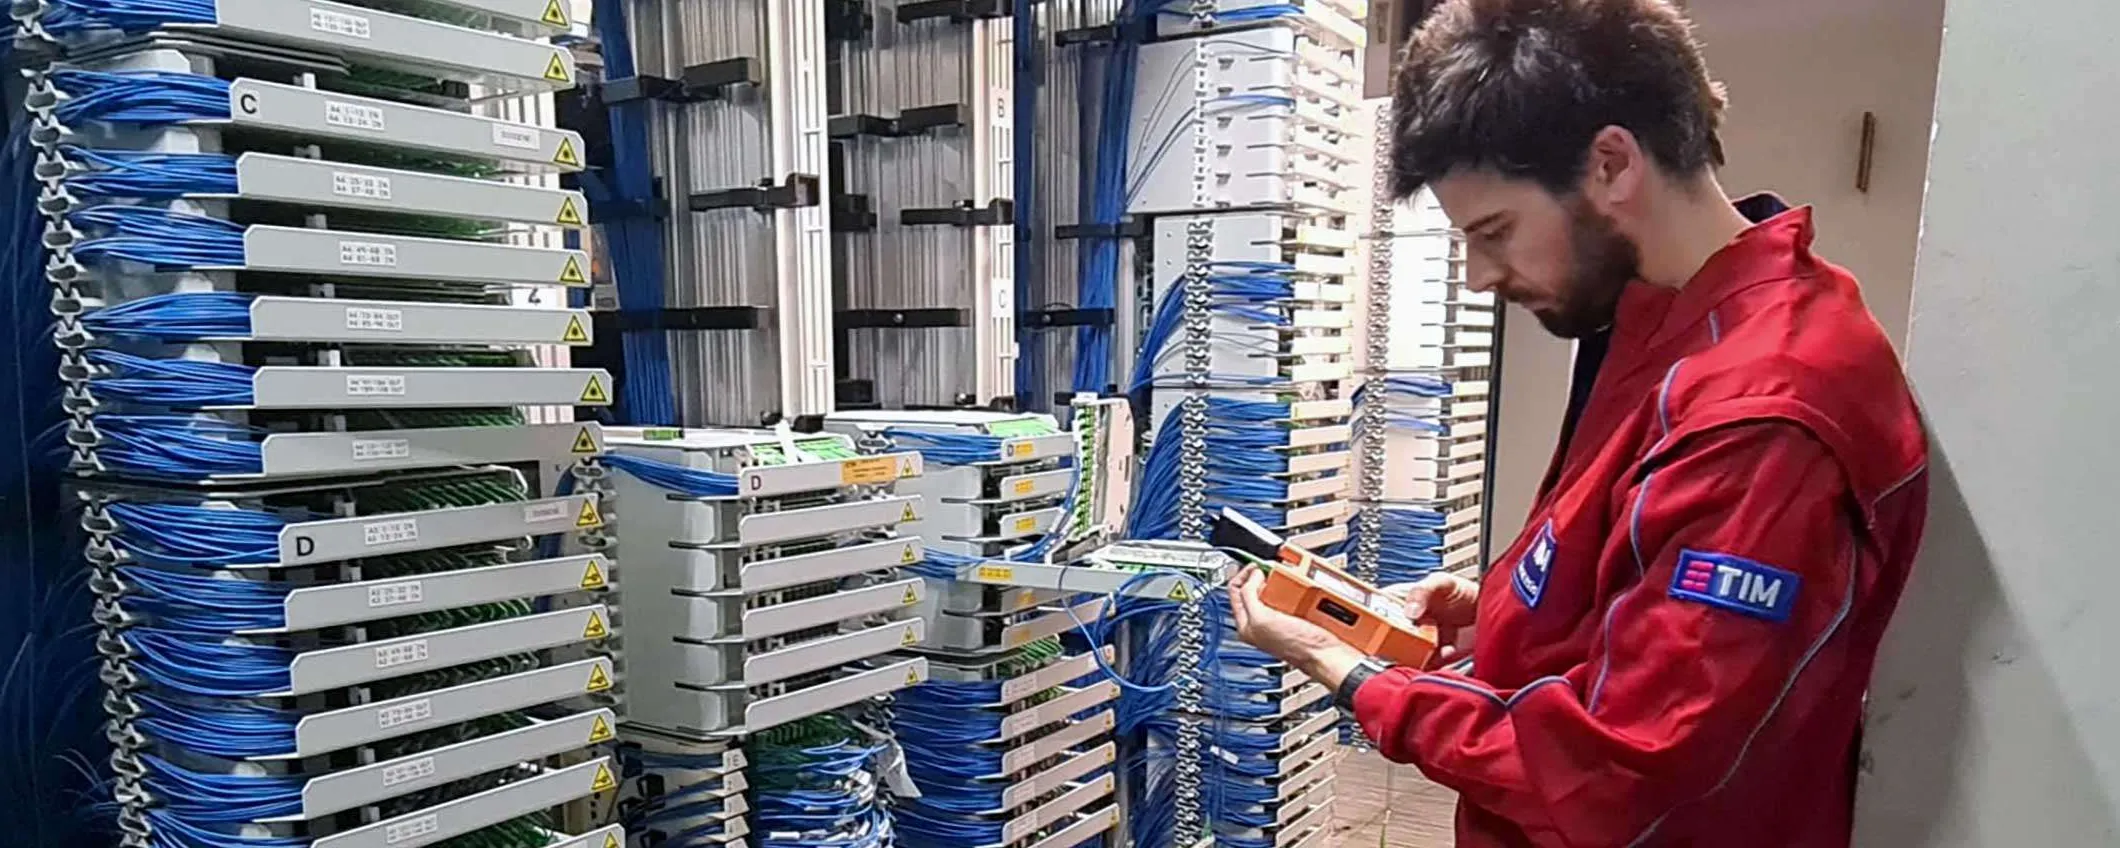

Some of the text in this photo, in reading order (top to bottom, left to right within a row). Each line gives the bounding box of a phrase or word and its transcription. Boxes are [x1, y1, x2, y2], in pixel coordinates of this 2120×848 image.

[241, 93, 257, 114] C
[996, 97, 1005, 119] B
[997, 290, 1007, 309] C
[750, 475, 762, 492] D
[296, 535, 315, 557] D
[1717, 565, 1783, 609] TIM
